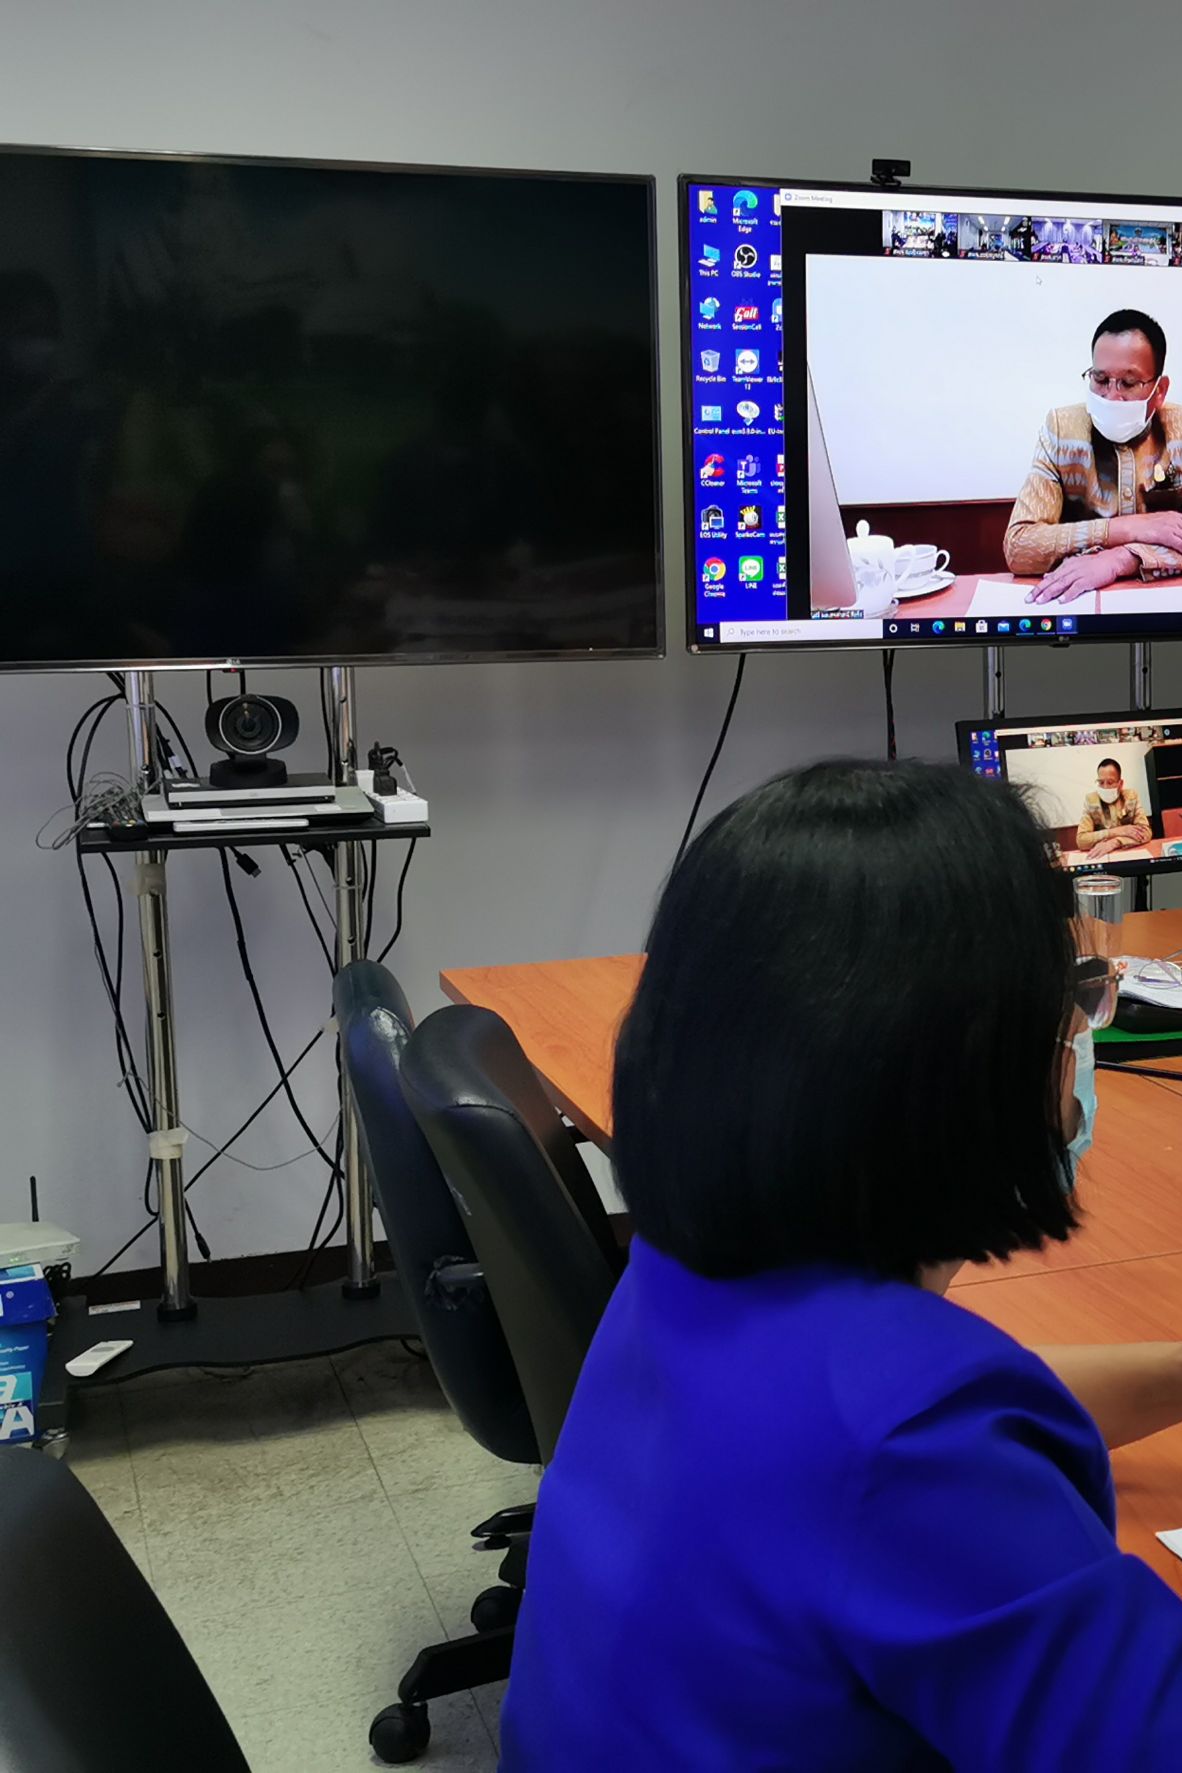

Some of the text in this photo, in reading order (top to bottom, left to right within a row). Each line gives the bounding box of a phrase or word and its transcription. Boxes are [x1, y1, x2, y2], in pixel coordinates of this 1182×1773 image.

[738, 225, 752, 234] Edge
[699, 269, 710, 277] This
[695, 375, 716, 384] Recycle
[704, 583, 724, 591] Google
[740, 628, 754, 637] Type
[756, 628, 770, 636] here
